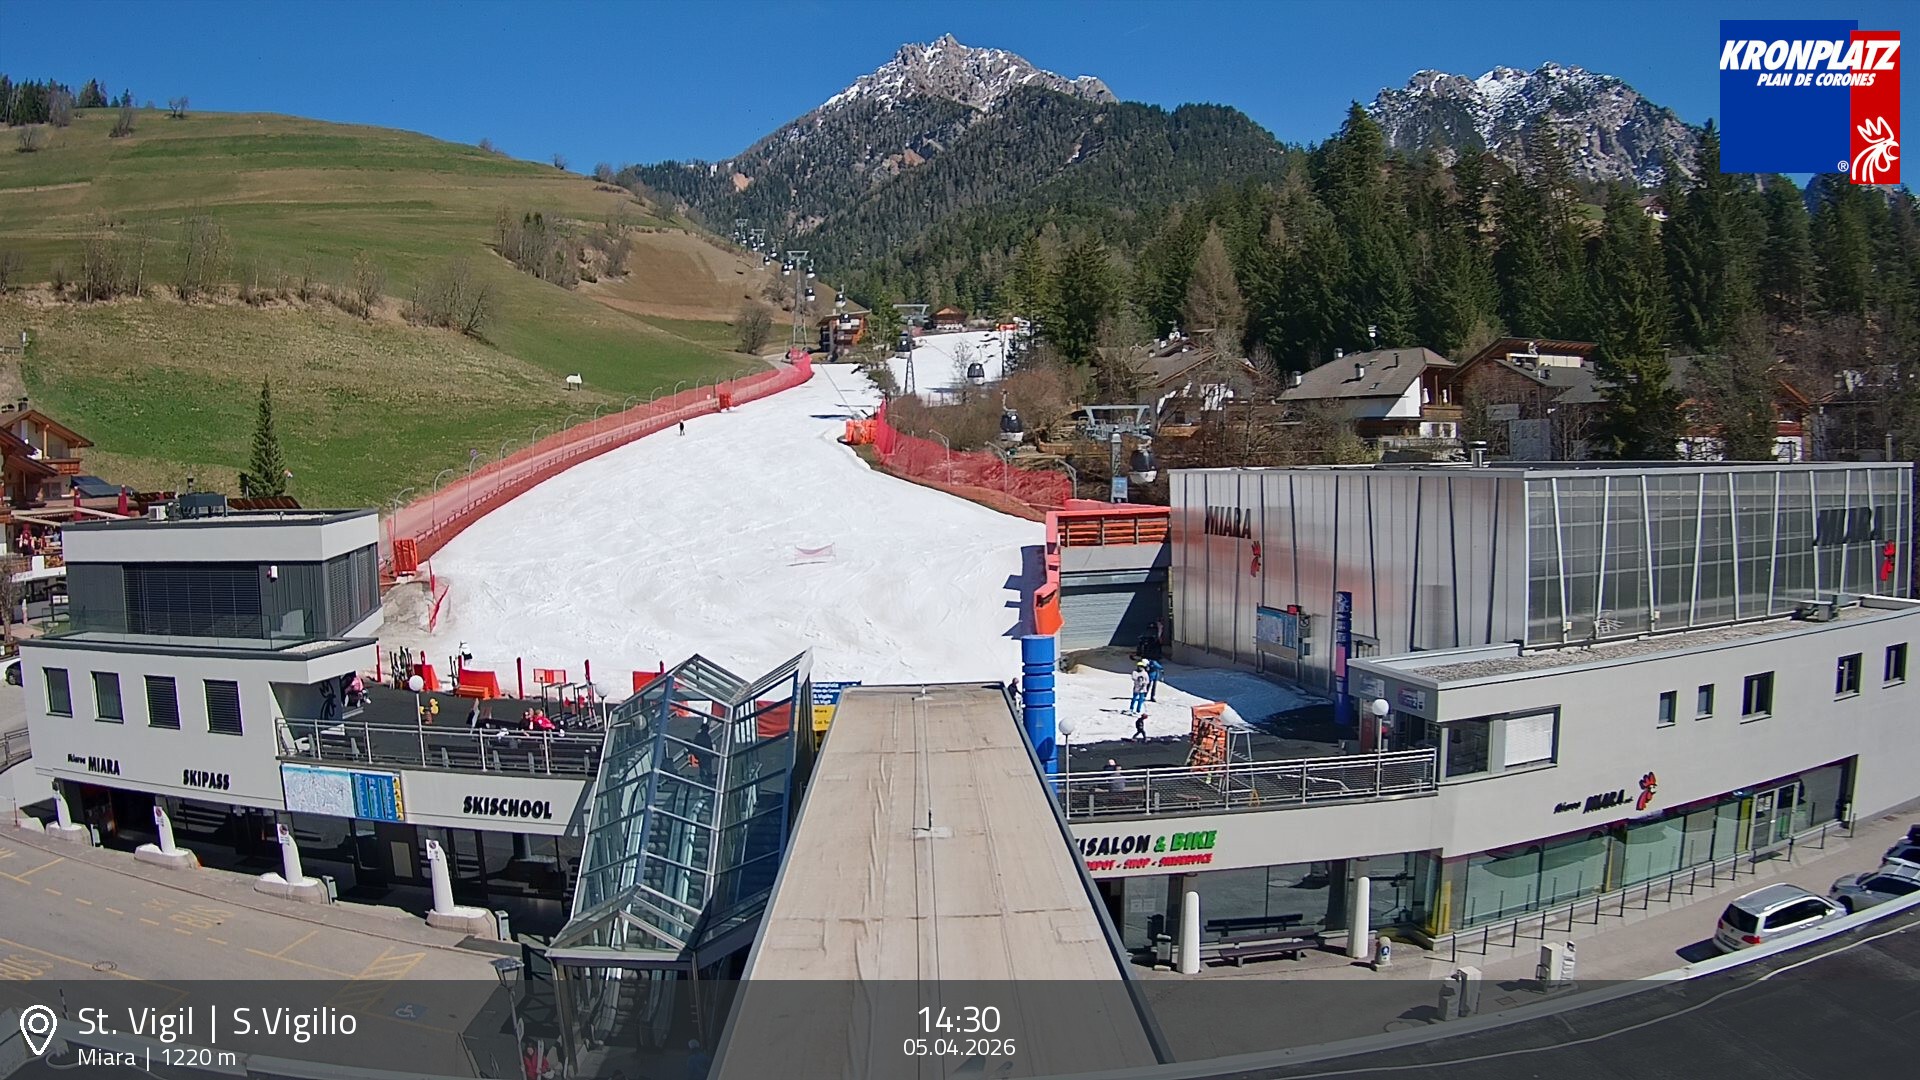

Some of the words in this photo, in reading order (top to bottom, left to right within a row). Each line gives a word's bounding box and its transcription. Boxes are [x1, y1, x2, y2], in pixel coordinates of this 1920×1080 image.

[1204, 505, 1252, 540] MIARA
[88, 756, 120, 776] MIARA
[182, 769, 230, 791] SKIPASS
[463, 795, 553, 820] SKISCHOOL
[1583, 789, 1625, 814] MIARA
[1075, 834, 1152, 856] ISALON
[1153, 836, 1166, 853] &
[1169, 830, 1218, 852] BIKE
[168, 905, 236, 930] BUS
